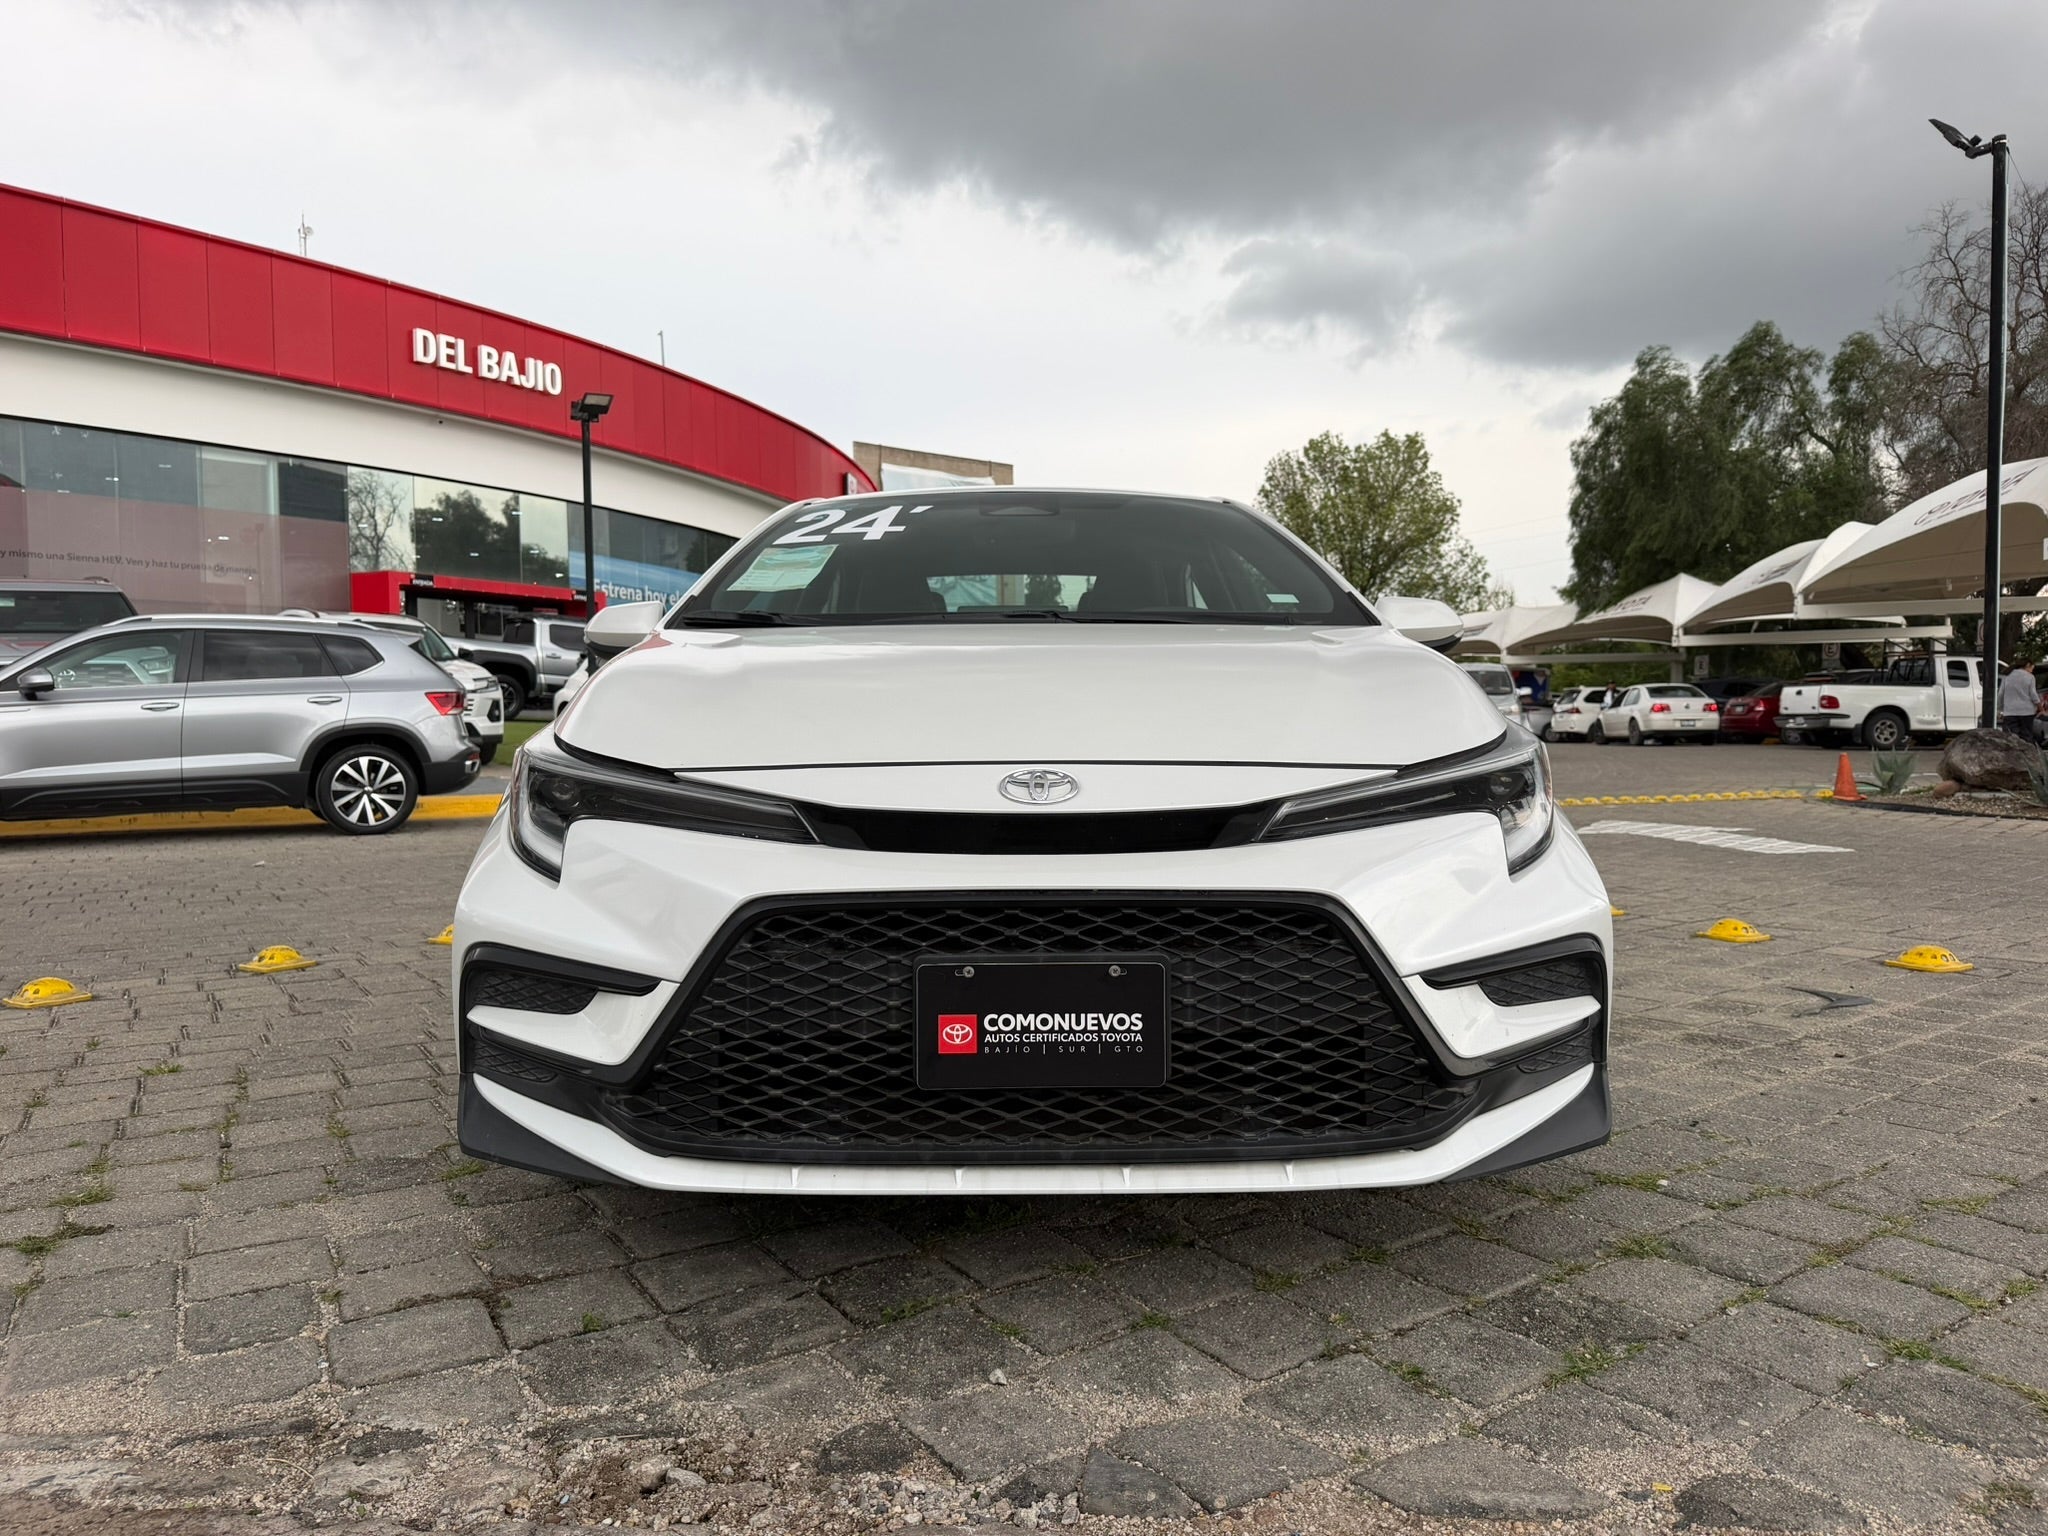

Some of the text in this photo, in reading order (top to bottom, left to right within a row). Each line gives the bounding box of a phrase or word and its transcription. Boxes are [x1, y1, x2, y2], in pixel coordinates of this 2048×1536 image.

[412, 327, 562, 396] DEL BAJIO
[8, 549, 44, 560] mismo
[46, 552, 65, 561] una
[66, 552, 100, 563] Sienna
[125, 557, 143, 567] Ven
[144, 559, 150, 568] y
[151, 558, 169, 568] haz
[170, 560, 179, 568] tu
[594, 579, 642, 600] Estrena
[983, 1013, 1143, 1031] COMONUEVOS
[984, 1033, 1143, 1043] AUTOS CERTIFICADOS TOYOTA
[1114, 1045, 1143, 1053] GTO
